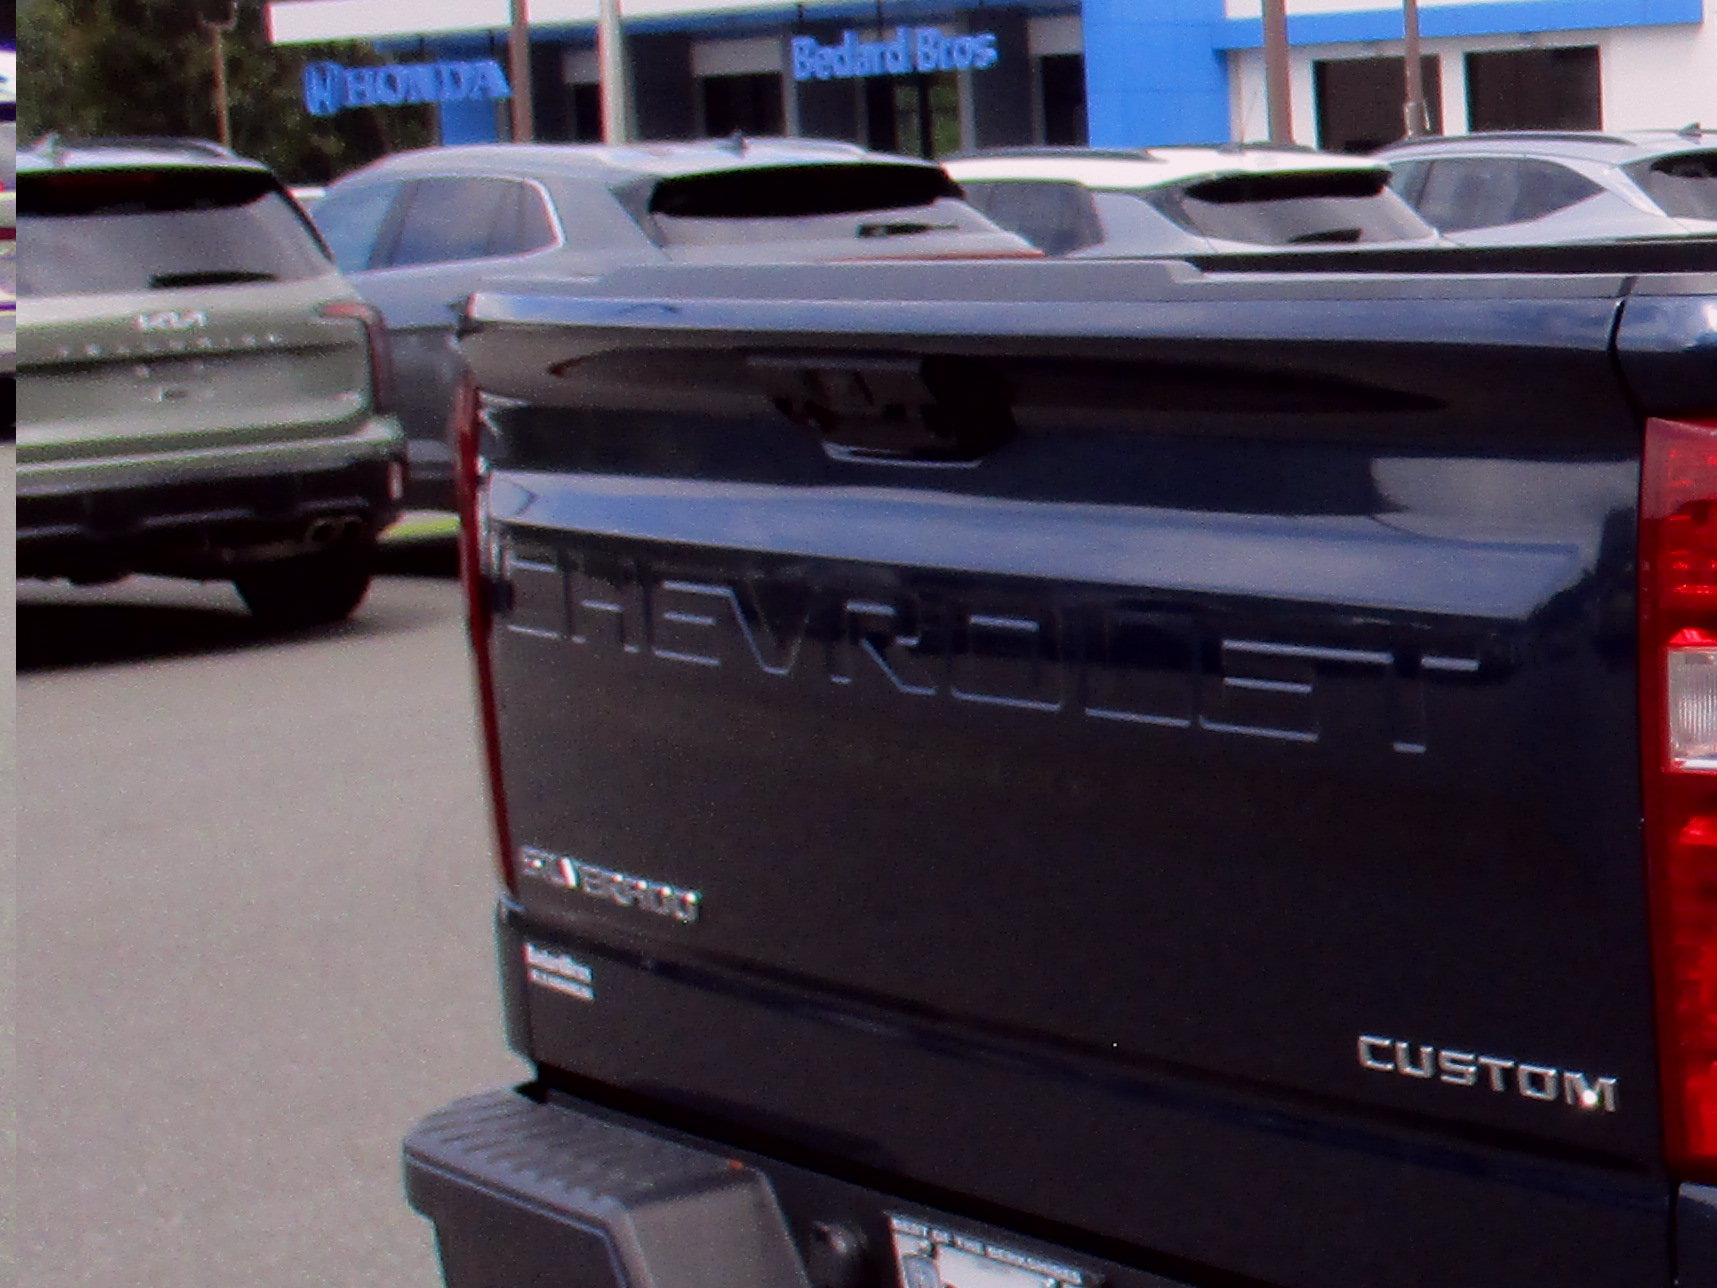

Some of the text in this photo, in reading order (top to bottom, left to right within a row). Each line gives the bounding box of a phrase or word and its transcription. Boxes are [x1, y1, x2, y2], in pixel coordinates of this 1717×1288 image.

[345, 60, 513, 107] HONDA
[791, 26, 913, 80] Bedard
[503, 554, 1480, 753] CHEVROLET
[1358, 1034, 1620, 1112] CUSTOM
